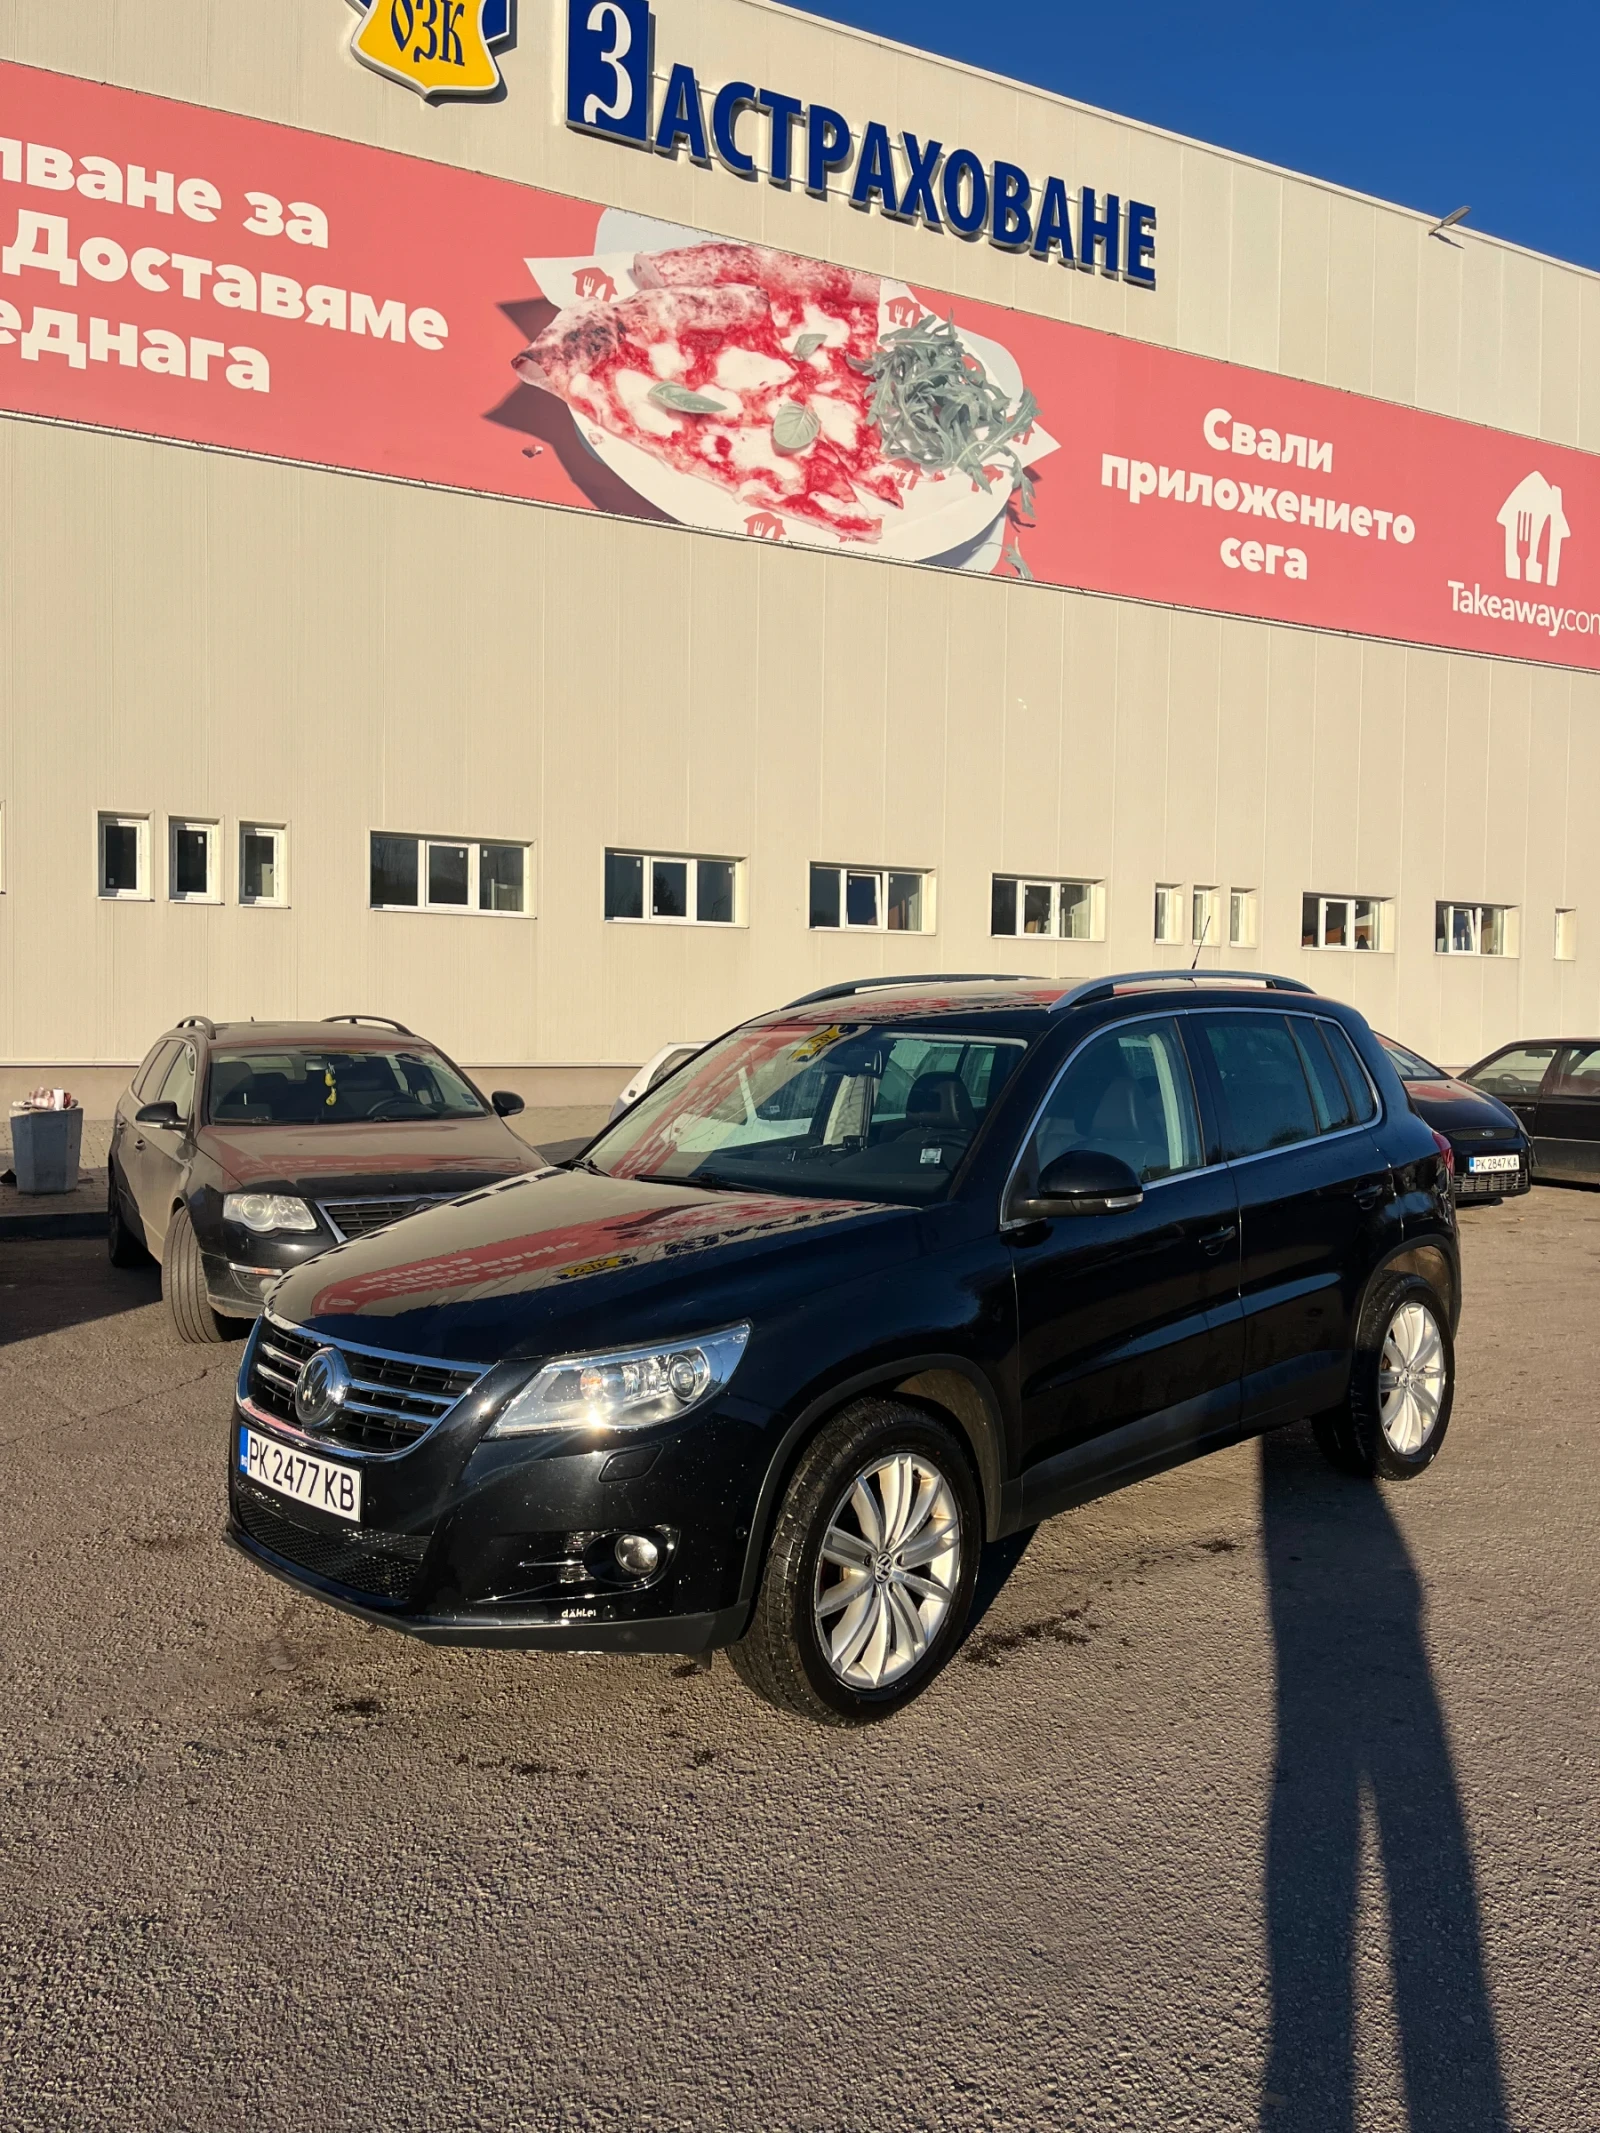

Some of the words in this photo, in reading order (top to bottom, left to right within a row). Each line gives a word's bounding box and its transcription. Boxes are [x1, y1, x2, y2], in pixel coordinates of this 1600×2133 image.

[390, 0, 466, 67] ОЗК
[584, 2, 1156, 284] ЗАСТРАХОВАНЕ
[243, 191, 329, 249] за
[2, 208, 449, 351] Доставяме
[1203, 408, 1334, 474] Свали
[1101, 453, 1416, 545] приложението
[1220, 537, 1308, 581] сега
[1475, 1160, 1487, 1170] PK
[1488, 1158, 1506, 1169] 2847
[1507, 1158, 1518, 1168] KA
[249, 1436, 269, 1480] PK
[272, 1449, 320, 1498] 2477
[324, 1467, 355, 1512] KB
